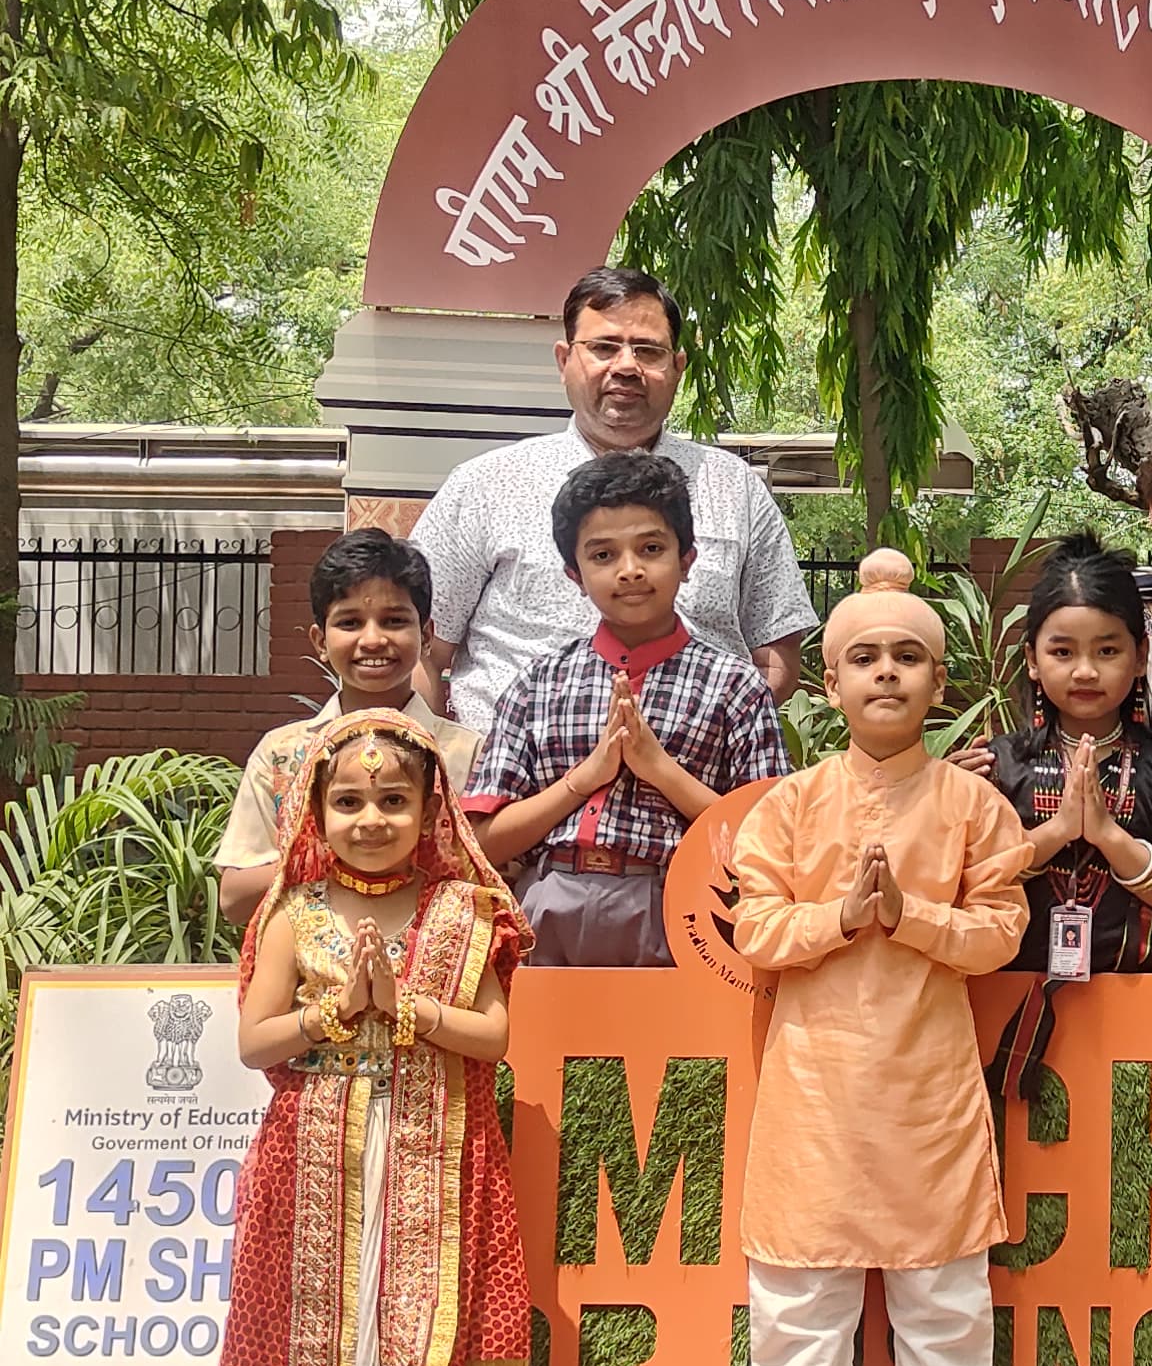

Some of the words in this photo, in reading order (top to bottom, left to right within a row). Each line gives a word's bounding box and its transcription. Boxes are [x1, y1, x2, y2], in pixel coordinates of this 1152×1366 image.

[434, 114, 564, 266] पीएम
[535, 27, 615, 145] श्री
[65, 1107, 154, 1130] Ministry
[160, 1107, 183, 1129] of
[92, 1136, 187, 1150] Goverment
[193, 1135, 213, 1150] Of
[217, 1135, 257, 1150] Indi
[26, 1238, 126, 1303] PM
[26, 1314, 220, 1357] SCHOO
